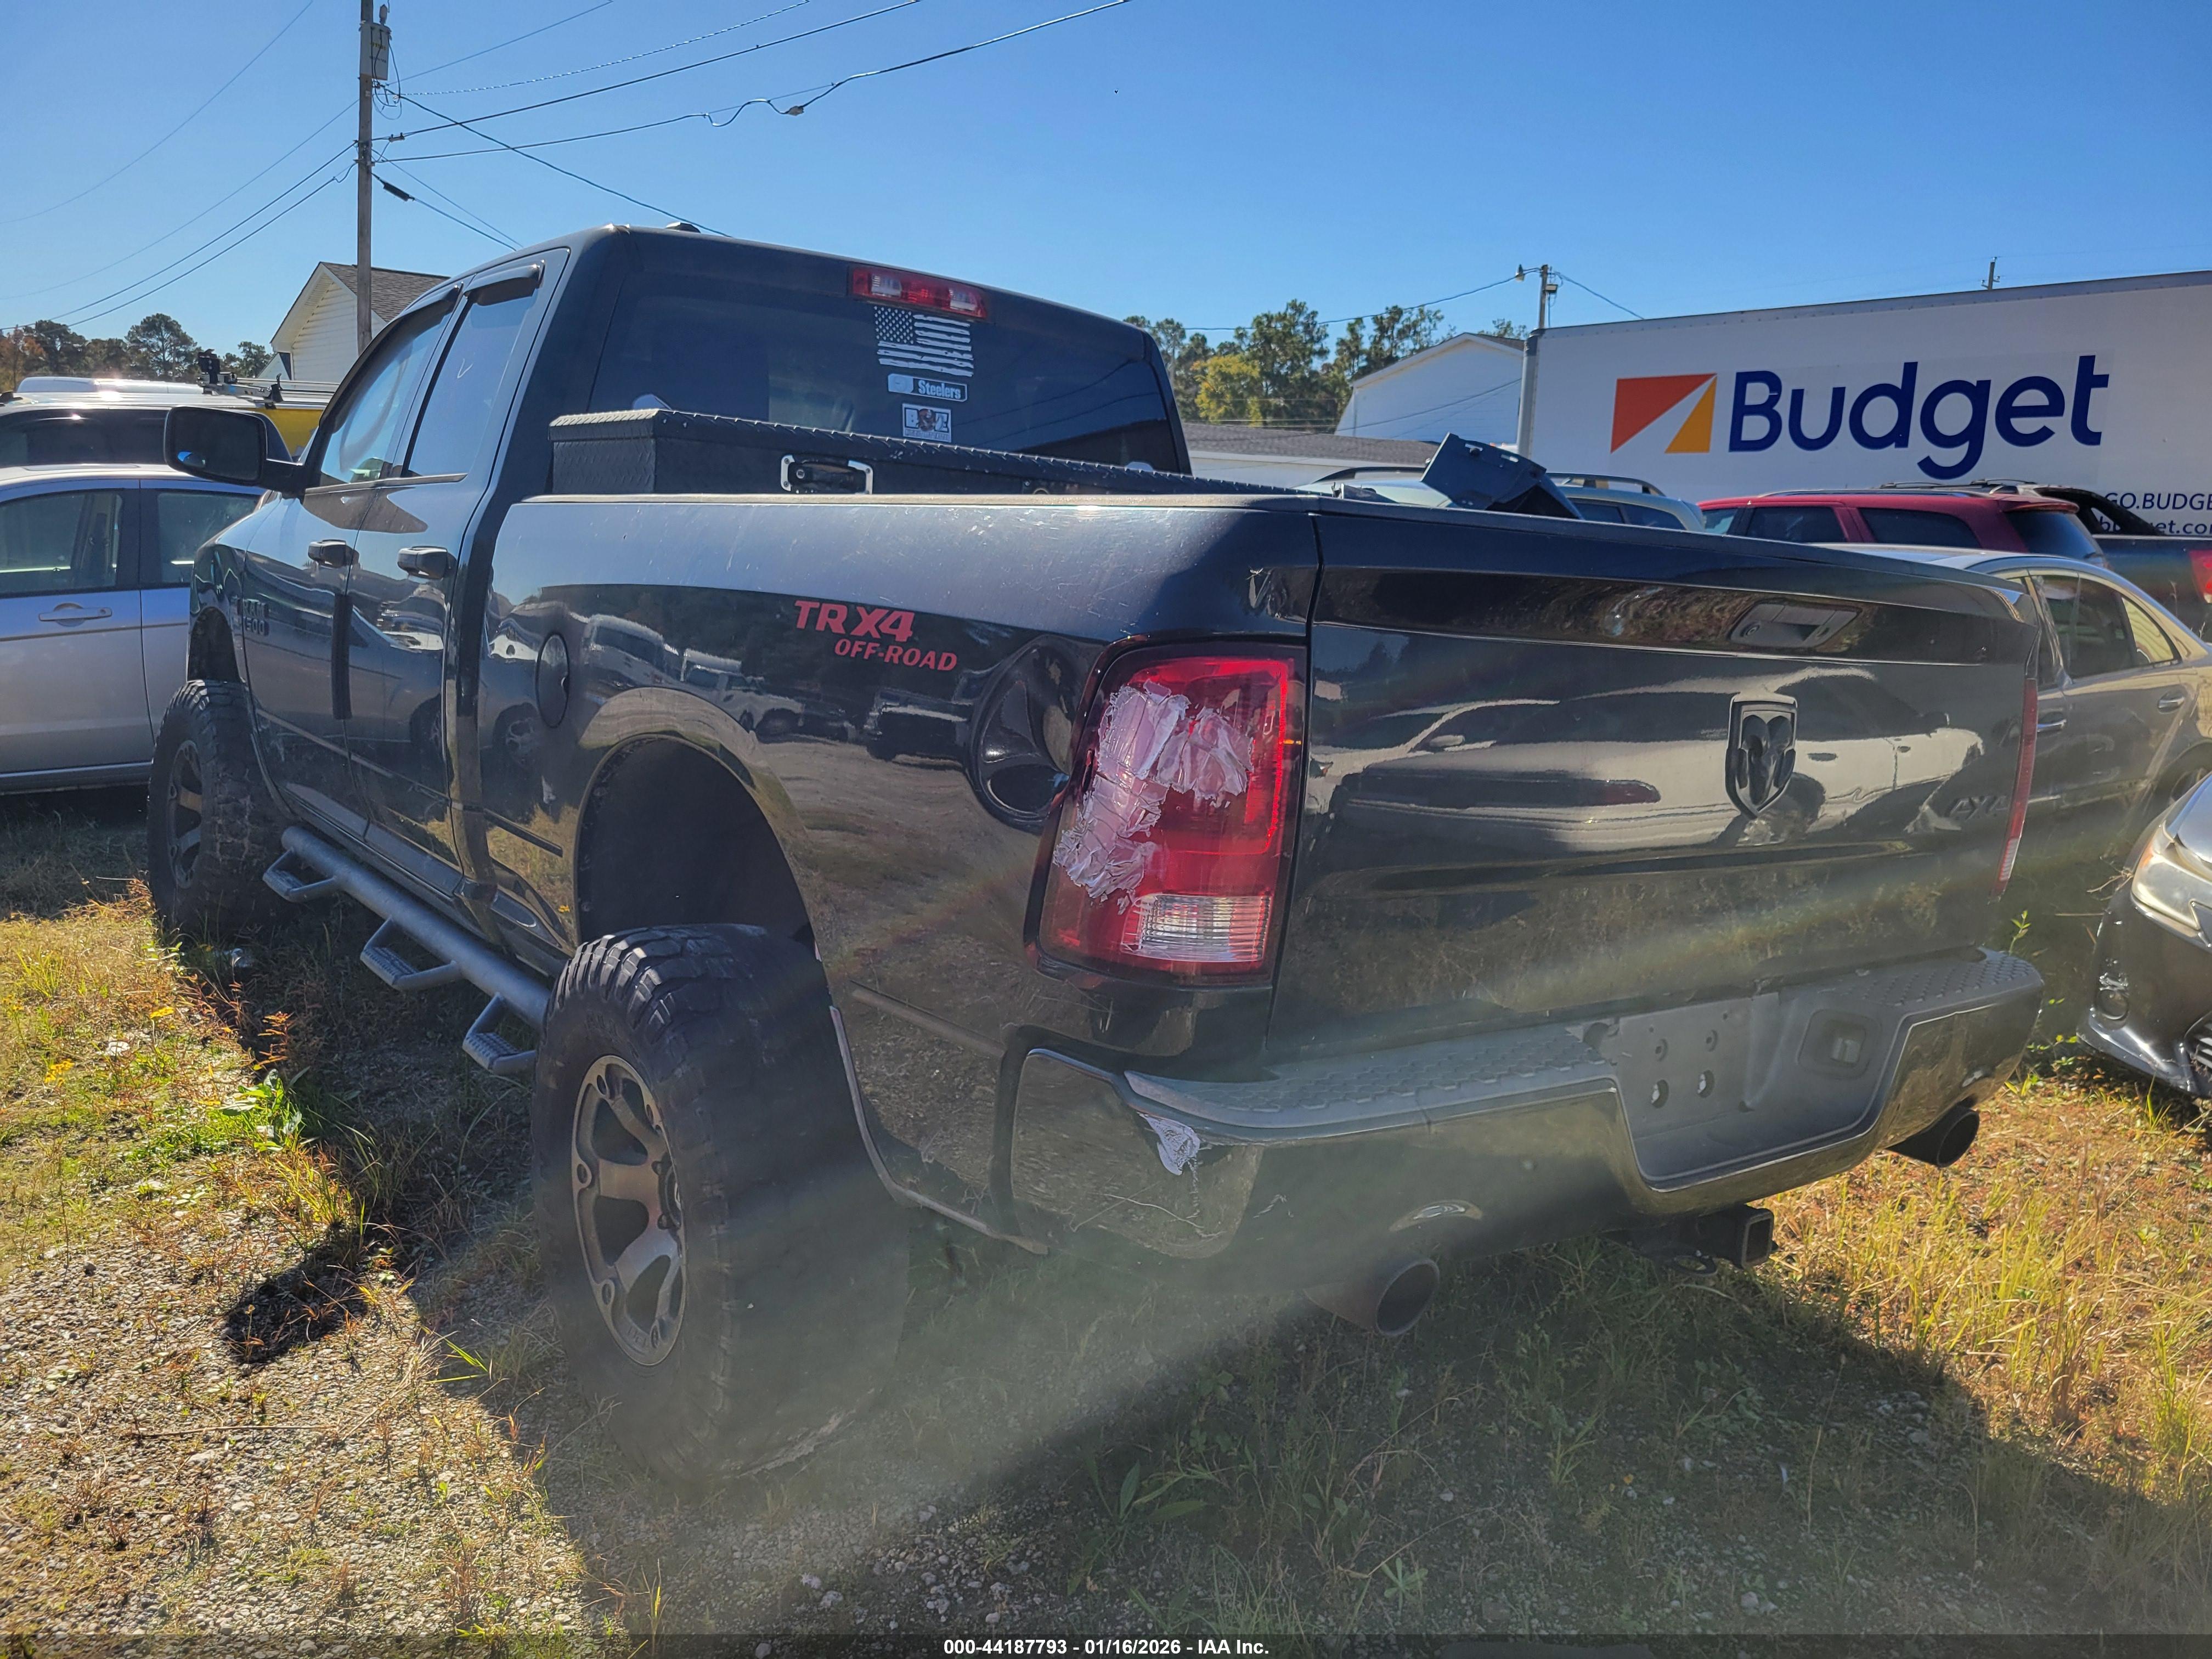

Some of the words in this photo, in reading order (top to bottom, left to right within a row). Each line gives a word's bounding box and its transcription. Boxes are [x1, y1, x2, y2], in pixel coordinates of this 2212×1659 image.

[918, 380, 961, 399] Steelers
[1729, 354, 2109, 480] Budget
[242, 598, 266, 618] RAM
[795, 600, 915, 642] TRX4
[834, 639, 957, 671] OFF-ROAD
